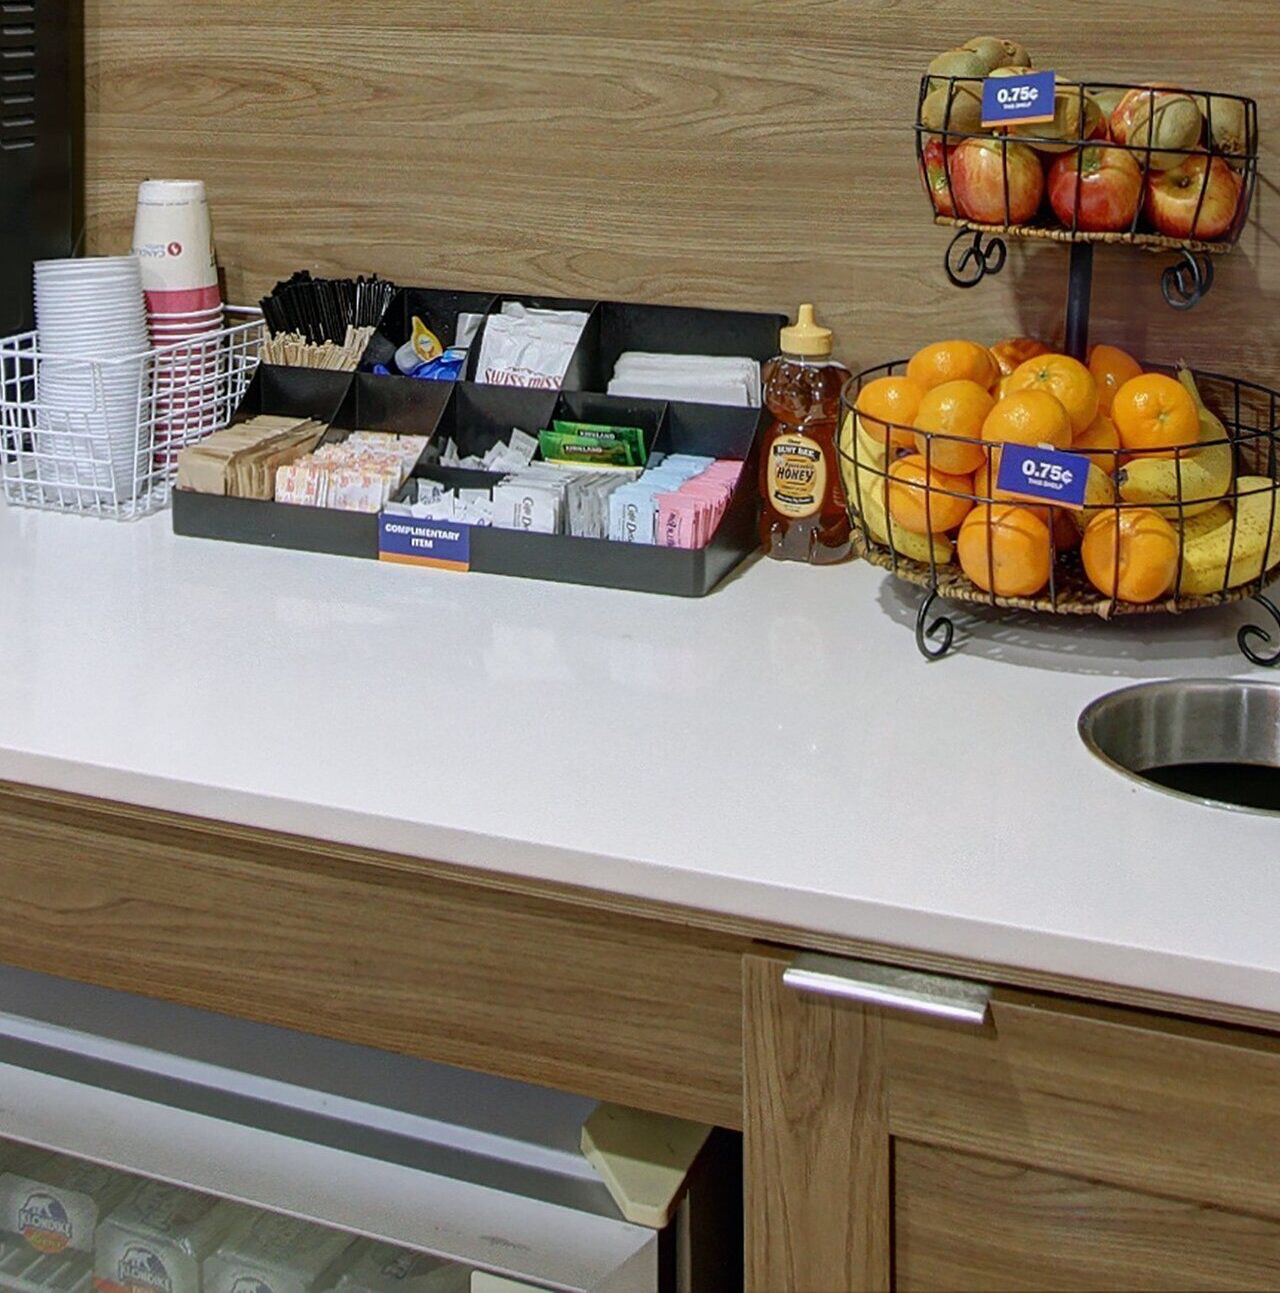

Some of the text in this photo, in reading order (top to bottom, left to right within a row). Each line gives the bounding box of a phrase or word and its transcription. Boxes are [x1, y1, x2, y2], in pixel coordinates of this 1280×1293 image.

[996, 86, 1039, 103] 0.75¢
[579, 430, 615, 440] KIRKLAND
[564, 444, 603, 454] KIRKLAND
[777, 467, 814, 483] HONEY
[1021, 459, 1074, 485] 0.75¢
[385, 523, 460, 541] COMPLIMENTARY
[411, 538, 433, 549] ITEM
[18, 1208, 73, 1238] KLONDIKE
